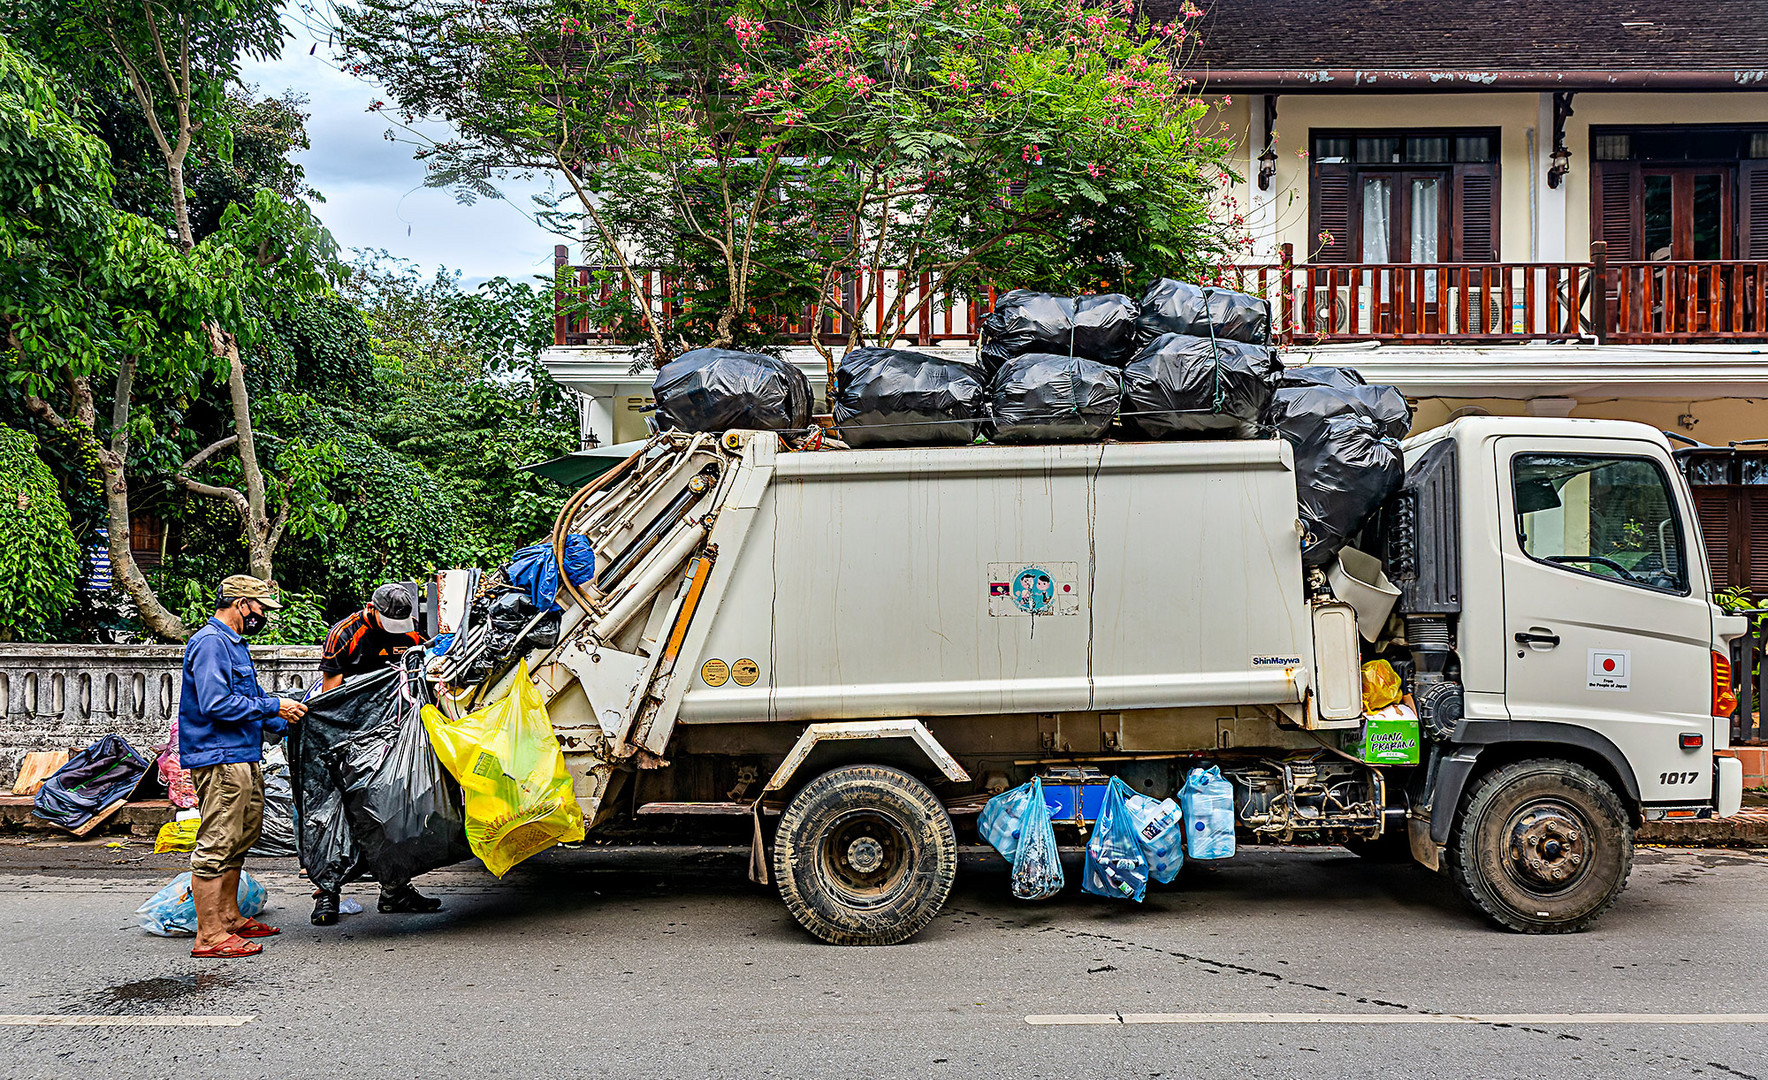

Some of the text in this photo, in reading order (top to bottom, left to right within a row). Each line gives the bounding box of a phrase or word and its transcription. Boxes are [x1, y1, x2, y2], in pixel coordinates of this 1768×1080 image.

[1253, 657, 1300, 665] ShinMaywa
[1370, 732, 1403, 742] LUANG
[1660, 772, 1699, 785] 1017
